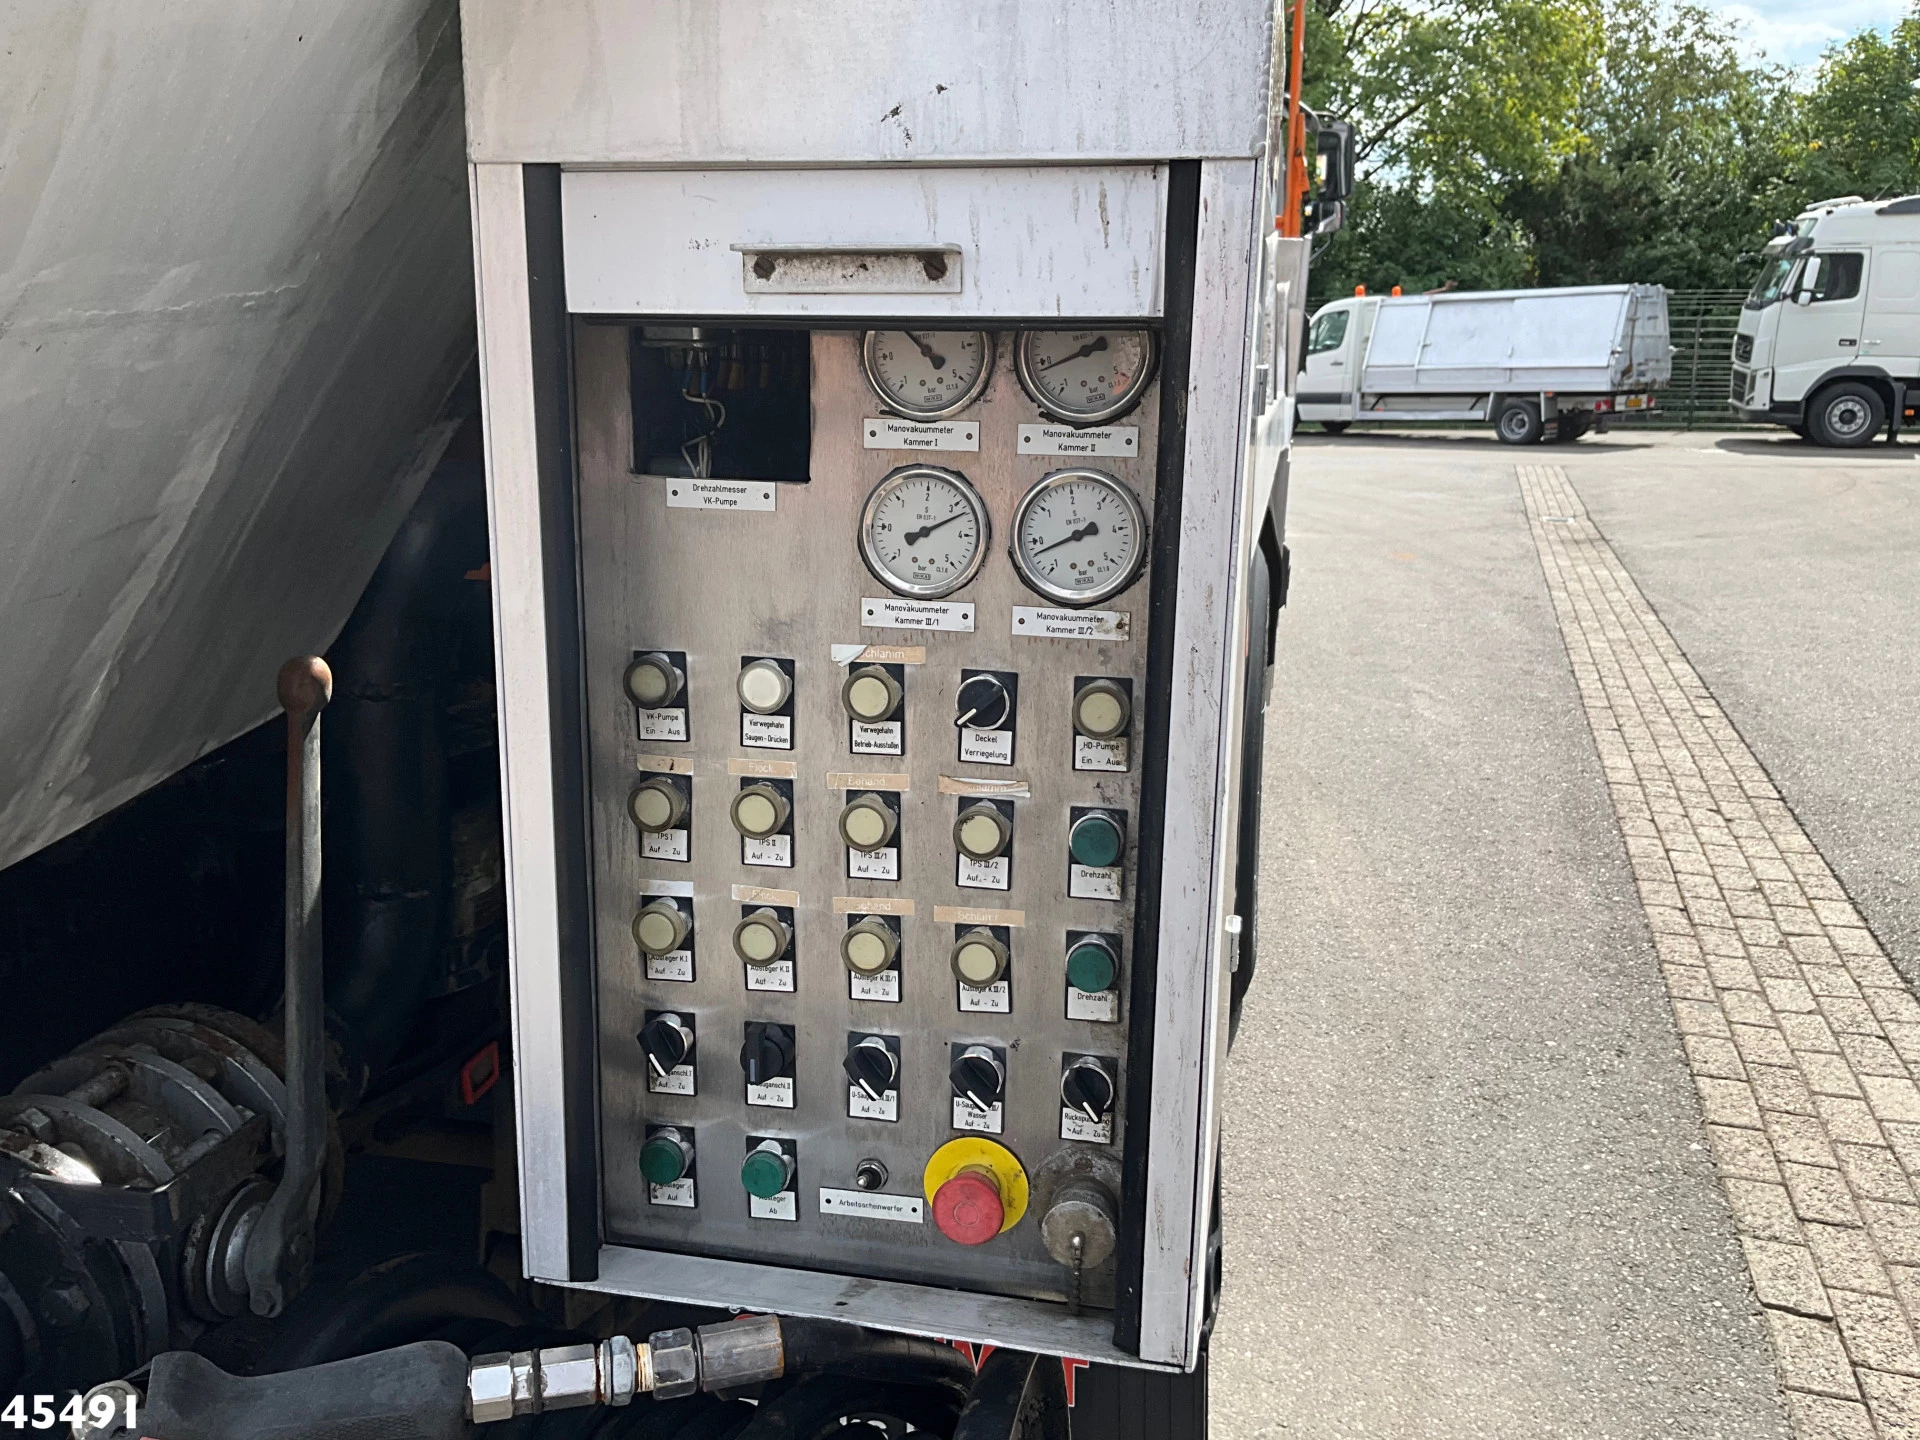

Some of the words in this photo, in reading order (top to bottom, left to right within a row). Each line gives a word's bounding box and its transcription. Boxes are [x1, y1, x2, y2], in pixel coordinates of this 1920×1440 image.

[961, 341, 966, 350] 4
[889, 352, 894, 360] 0
[952, 369, 957, 378] 5
[1114, 366, 1119, 375] 5
[887, 424, 954, 434] Manovakuummeter
[1043, 430, 1112, 439] Manovakuummeter
[903, 438, 933, 446] Kammer
[1058, 443, 1089, 452] Kammer
[1091, 444, 1096, 452] II
[692, 484, 747, 494] Drehzahlmesser
[926, 493, 930, 501] 2
[1071, 496, 1075, 504] 2
[703, 497, 738, 507] VK-Pumpe
[901, 500, 905, 508] 1
[1097, 502, 1102, 510] 3
[949, 505, 954, 513] 3
[1047, 510, 1051, 518] 1
[888, 524, 892, 532] 0
[1112, 525, 1117, 533] 4
[958, 531, 963, 539] 4
[1039, 536, 1044, 545] 0
[893, 549, 901, 557] -1
[1103, 552, 1109, 560] 5
[945, 554, 949, 562] 5
[1050, 559, 1058, 567] -1
[884, 603, 950, 615] Manovakuummeter
[894, 616, 923, 625] Kammer
[925, 617, 939, 626] III/1
[1036, 612, 1105, 624] Manovakuummeter
[1046, 625, 1077, 635] Kammer
[1078, 626, 1094, 636] III/2
[861, 647, 905, 659] chlamm
[646, 713, 679, 722] VK-Pumpe
[749, 719, 785, 729] Vierwegehahn
[646, 727, 656, 735] Ein
[667, 728, 680, 736] Aus
[860, 726, 894, 735] Vierwegehahn
[745, 733, 763, 743] Saugen
[975, 734, 998, 744] Deckel
[1082, 741, 1120, 752] HD-Pumpe
[964, 748, 1008, 760] Verriegelung
[1081, 756, 1093, 764] Ein
[1106, 757, 1121, 766] Aus
[657, 833, 669, 841] TPS
[758, 839, 771, 847] TPS
[672, 848, 681, 856] Zu
[860, 851, 873, 860] TPS
[775, 854, 784, 862] Zu
[969, 860, 983, 868] TPS
[881, 866, 890, 875] Zu
[1080, 870, 1112, 879] Drehzahl
[992, 876, 1000, 884] Zu
[778, 979, 787, 987] Zu
[881, 988, 890, 996] Zu
[1077, 992, 1108, 1002] Drehzahl
[970, 999, 981, 1007] Auf
[990, 1000, 999, 1008] Zu
[678, 1082, 686, 1090] Zu
[776, 1095, 784, 1103] Zu
[878, 1107, 886, 1115] Zu
[967, 1111, 987, 1120] Wasser
[964, 1119, 974, 1127] Auf
[983, 1121, 990, 1129] Zu
[1071, 1127, 1083, 1135] Auf
[1093, 1129, 1101, 1138] Zu
[838, 1199, 903, 1212] Arbeitsscheinwerfer
[769, 1207, 778, 1215] Ab
